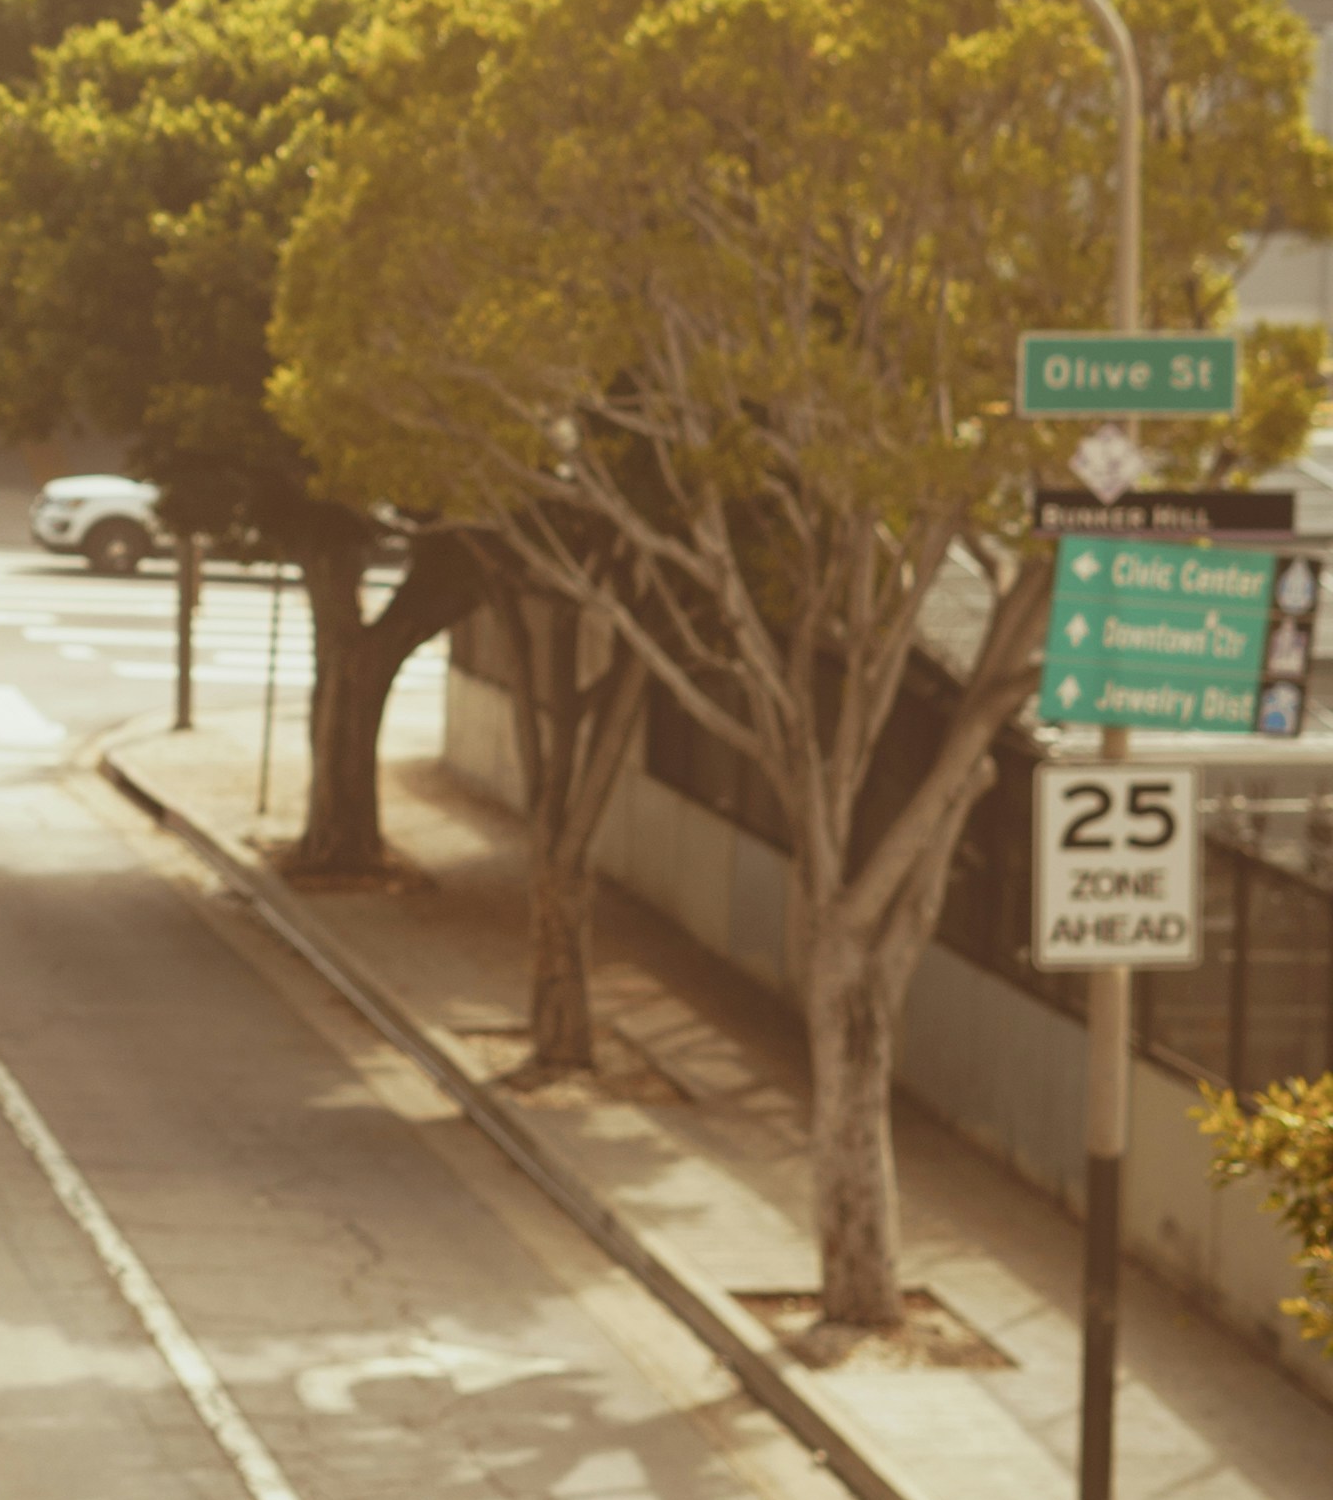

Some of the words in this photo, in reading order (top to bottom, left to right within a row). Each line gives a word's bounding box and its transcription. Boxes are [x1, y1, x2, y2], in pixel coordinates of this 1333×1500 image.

[1043, 353, 1151, 390] Olive
[1170, 354, 1213, 390] St
[1041, 503, 1147, 529] BUNKER
[1151, 503, 1209, 529] HILL
[1111, 552, 1174, 591] Civic
[1180, 558, 1265, 597] Center
[1103, 616, 1208, 655] Downtown
[1210, 622, 1247, 659] Ctr
[1095, 681, 1197, 723] Jewelry
[1201, 685, 1254, 722] Dist
[1061, 783, 1176, 850] 25
[1070, 869, 1166, 900] ZONE
[1050, 912, 1186, 946] AHEAD
